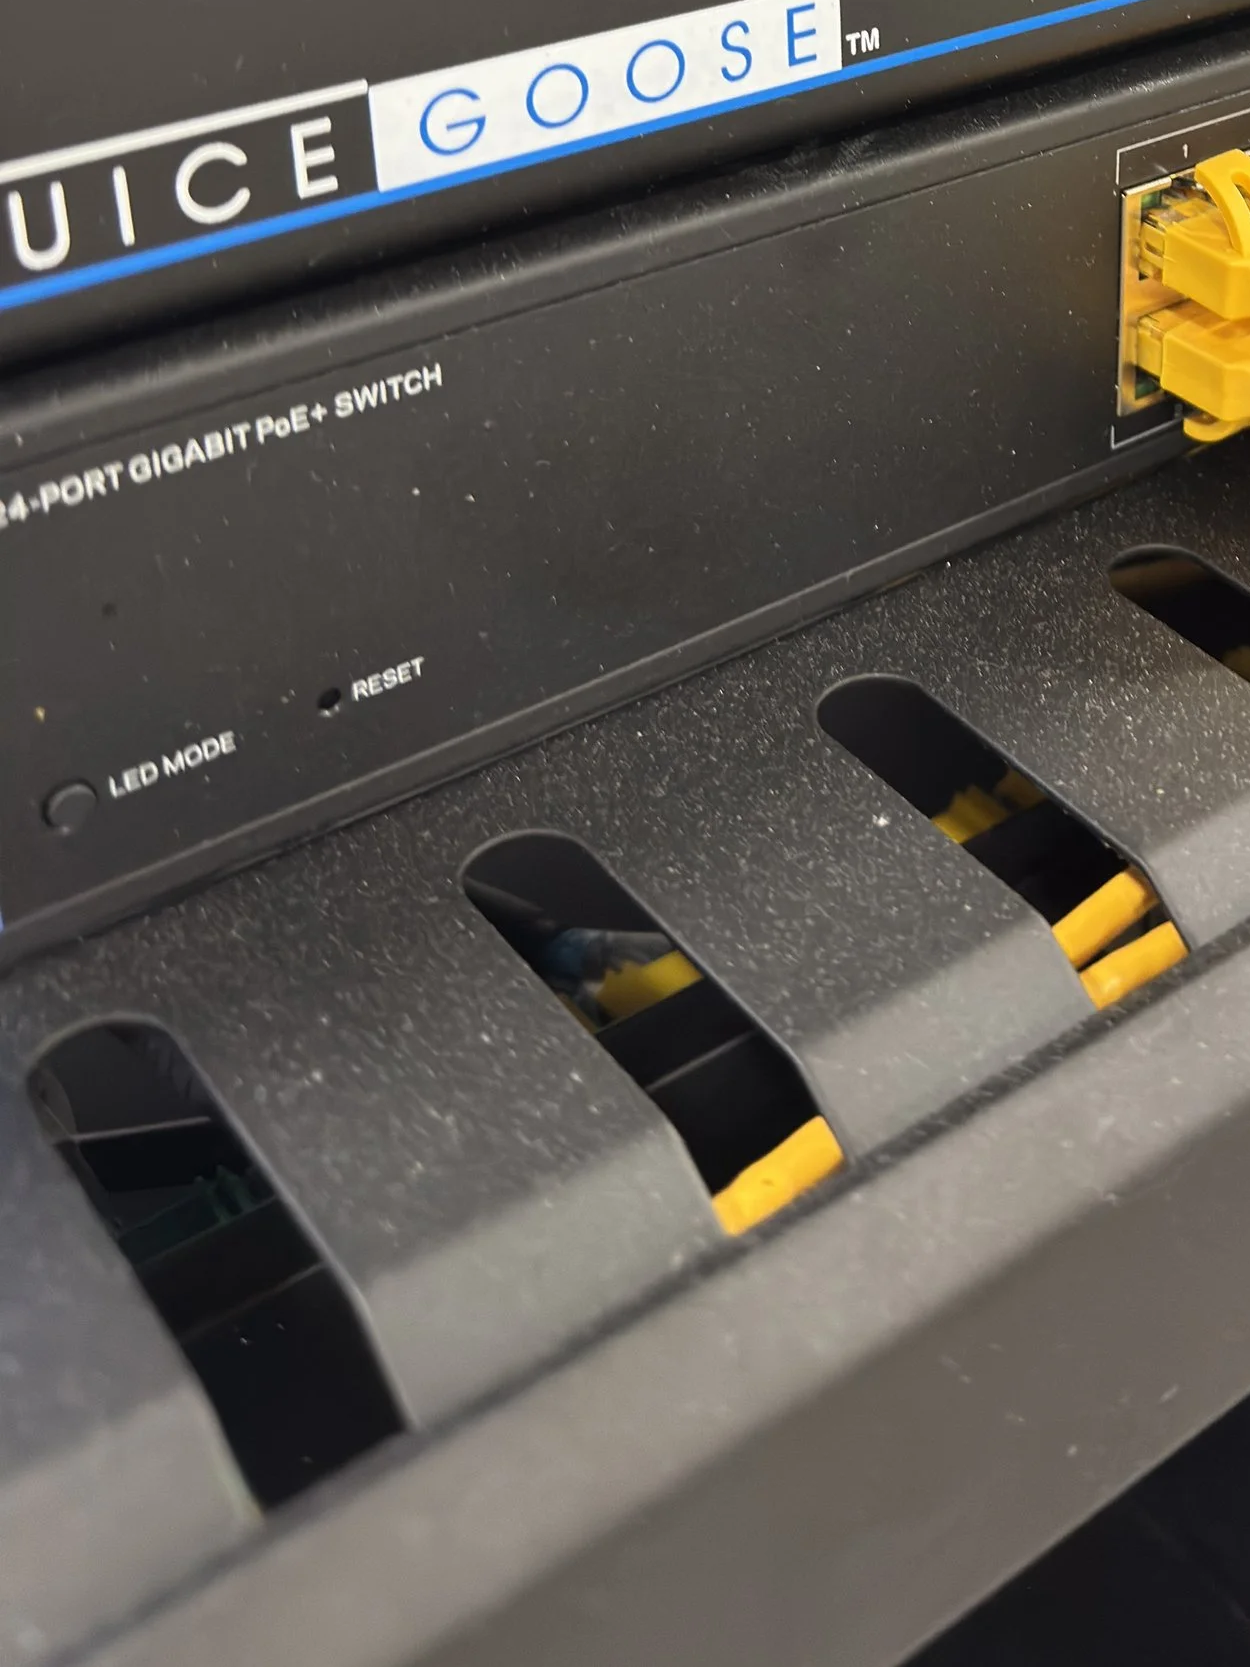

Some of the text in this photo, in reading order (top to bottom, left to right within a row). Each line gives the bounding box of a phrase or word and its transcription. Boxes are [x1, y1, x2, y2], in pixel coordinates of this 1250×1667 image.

[419, 1, 818, 156] GOOSE
[128, 420, 250, 484] GIGABIT
[256, 403, 328, 445] PoE+
[334, 362, 443, 419] SWITCH
[352, 657, 424, 701] RESET
[108, 731, 236, 799] LED MODE
